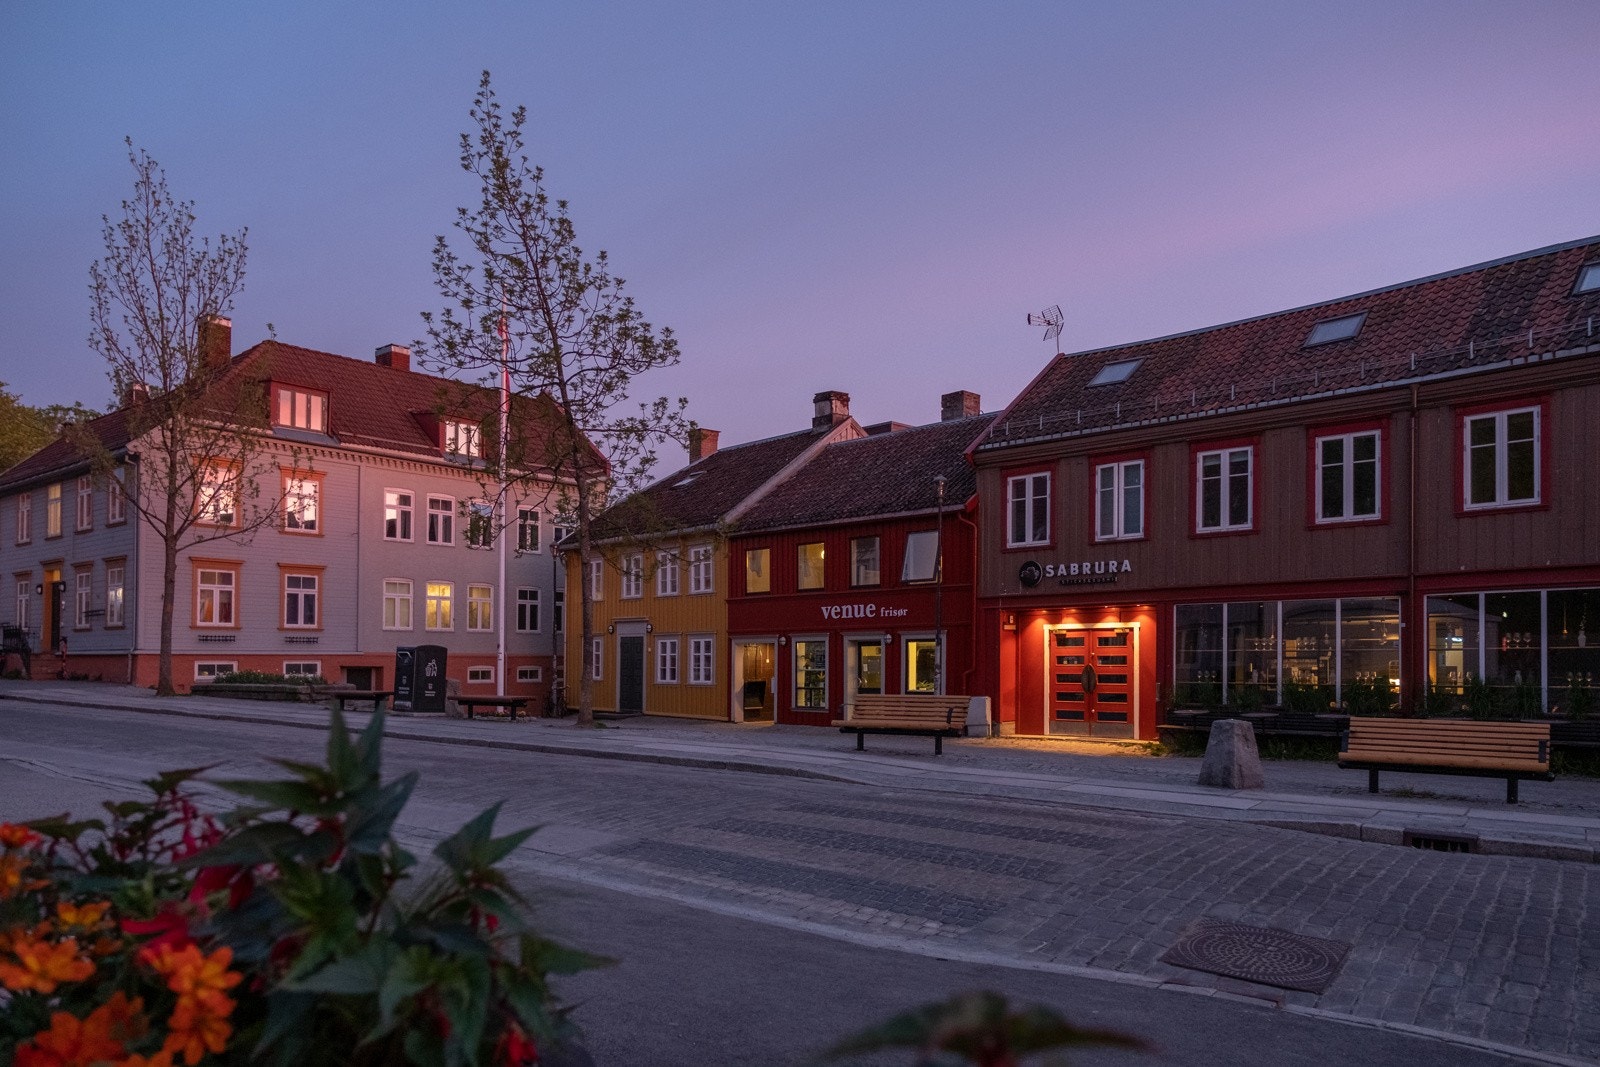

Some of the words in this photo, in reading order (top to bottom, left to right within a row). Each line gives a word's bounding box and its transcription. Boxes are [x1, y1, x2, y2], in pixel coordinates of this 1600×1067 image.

[1045, 559, 1132, 577] SABRURA
[821, 603, 876, 620] venue
[880, 606, 908, 618] frisør
